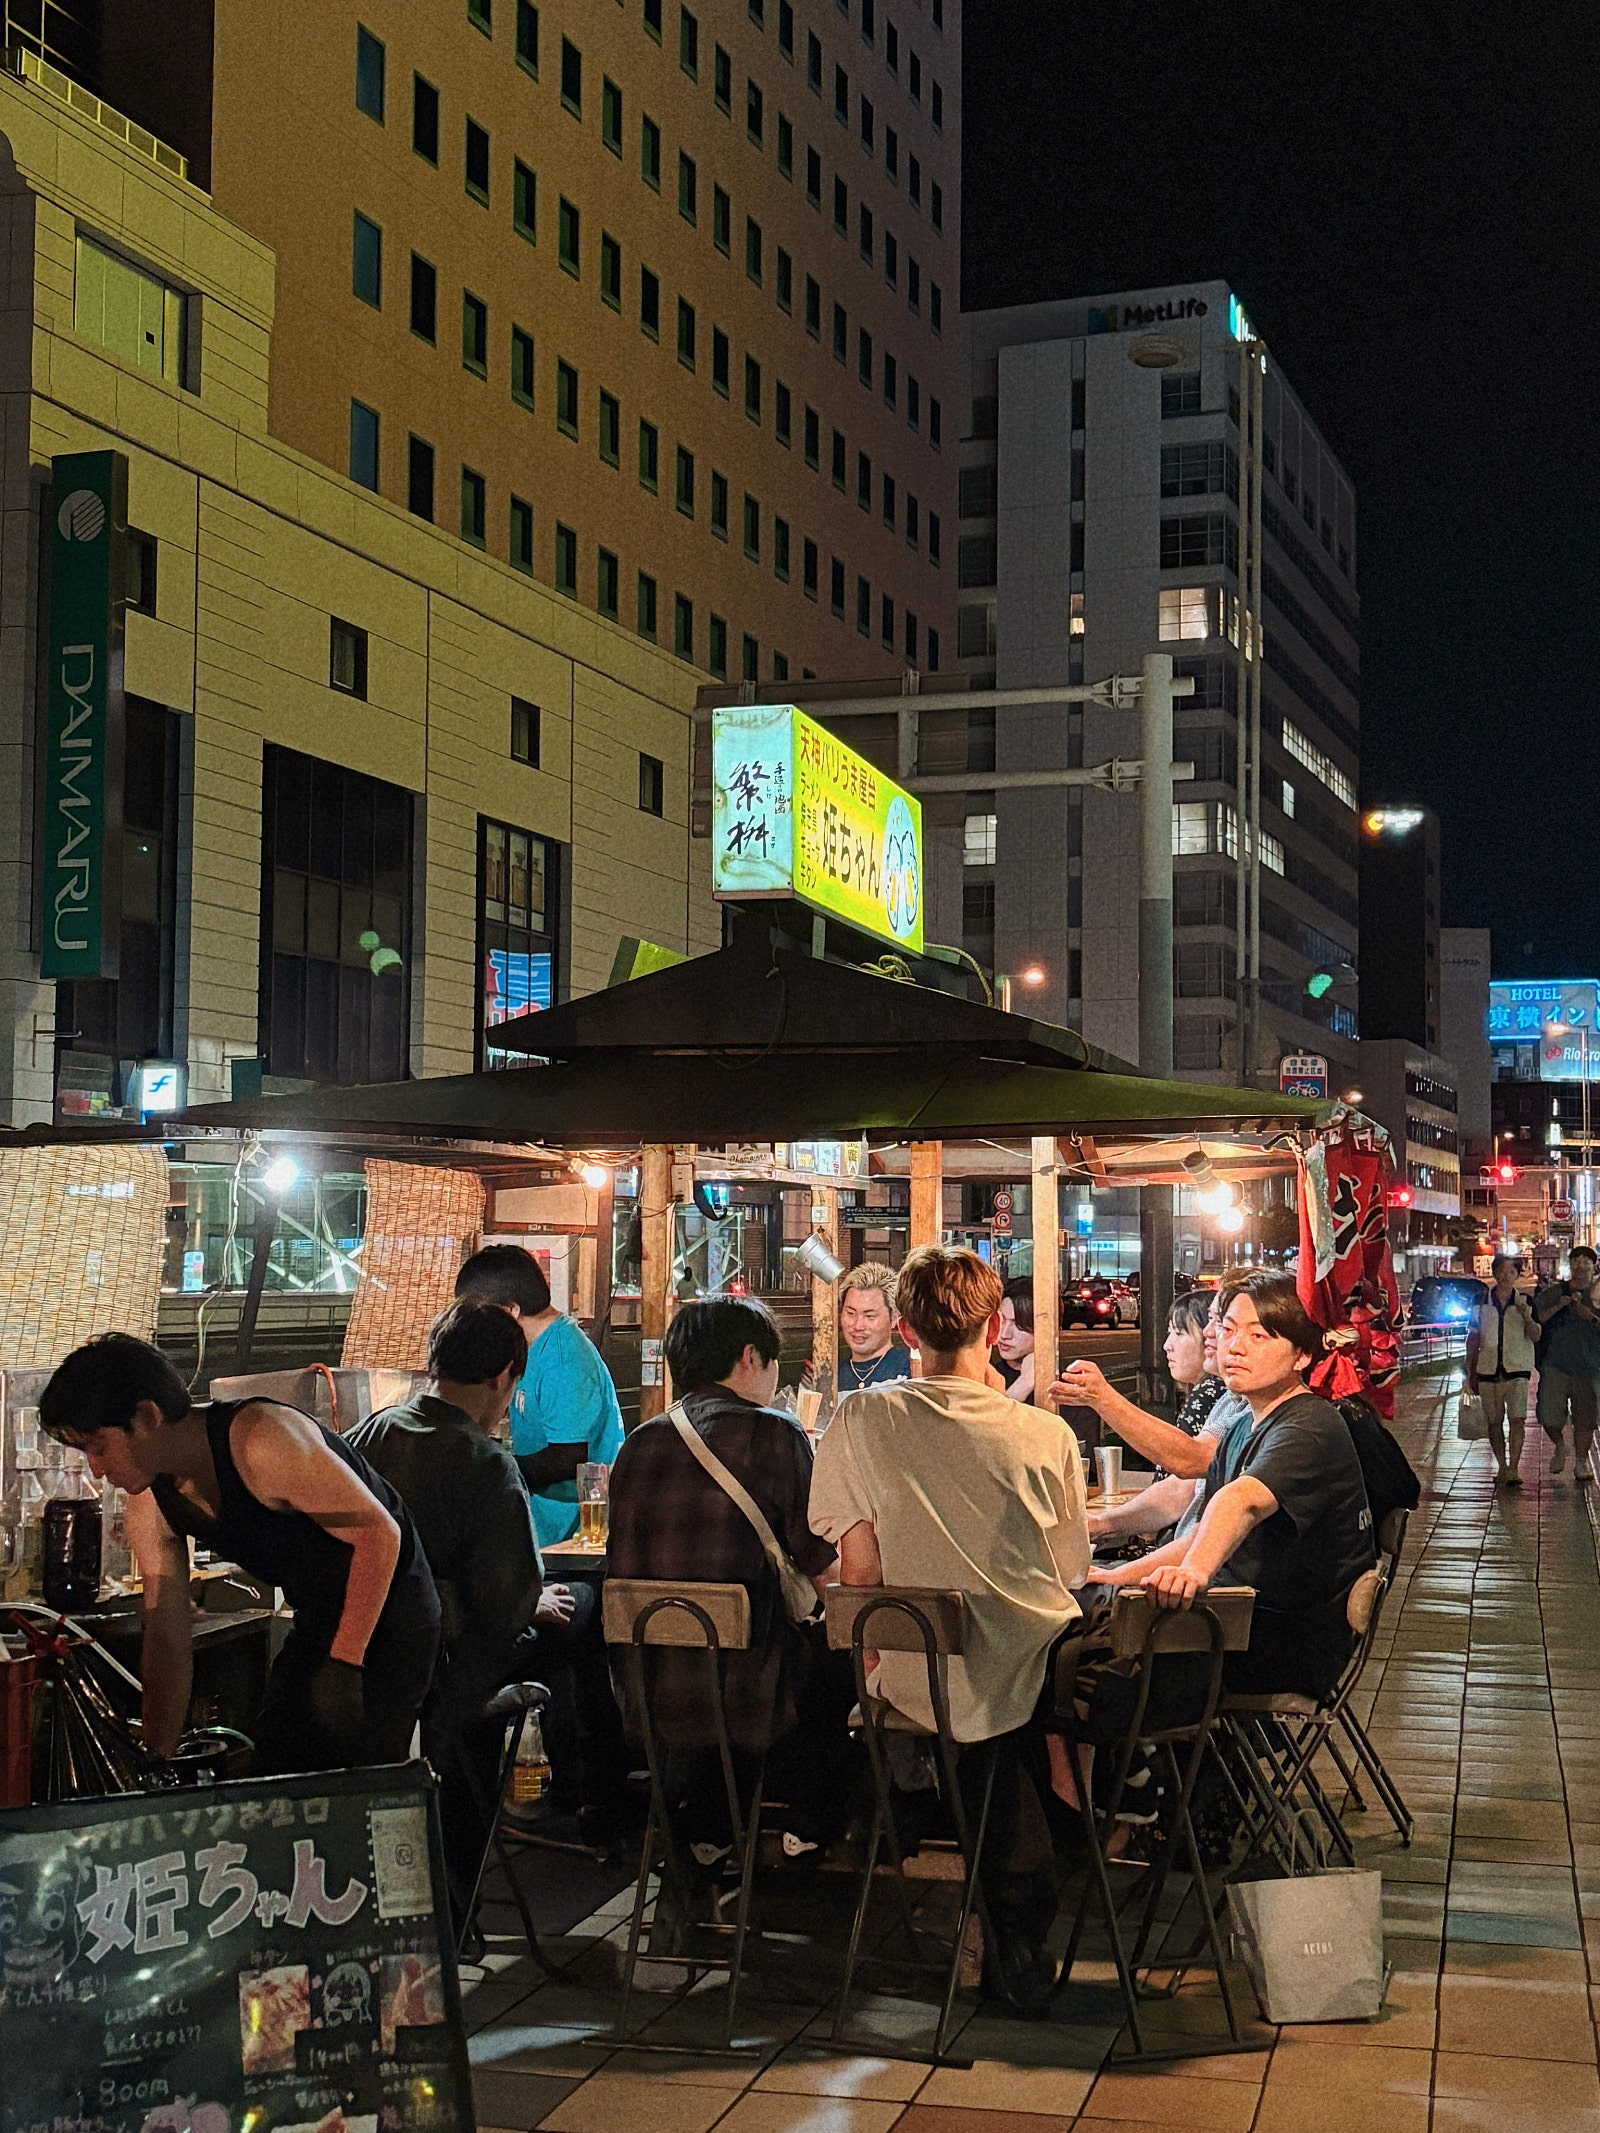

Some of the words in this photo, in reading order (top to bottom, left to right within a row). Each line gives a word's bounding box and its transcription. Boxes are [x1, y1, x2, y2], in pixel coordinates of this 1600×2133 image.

[1124, 298, 1208, 326] MetLife
[800, 723, 876, 813] 天神バリうま屋台
[53, 644, 95, 951] DAIMARU
[800, 771, 820, 804] ラーメン
[823, 796, 881, 899] 姫ちゃん
[1511, 987, 1562, 1002] HOTEL
[1489, 1005, 1586, 1029] 東横イン
[999, 1197, 1008, 1206] 40
[76, 1840, 368, 1963] 姫ちゃん
[1304, 1942, 1333, 1955] ACTUS
[100, 2078, 169, 2106] 800円
